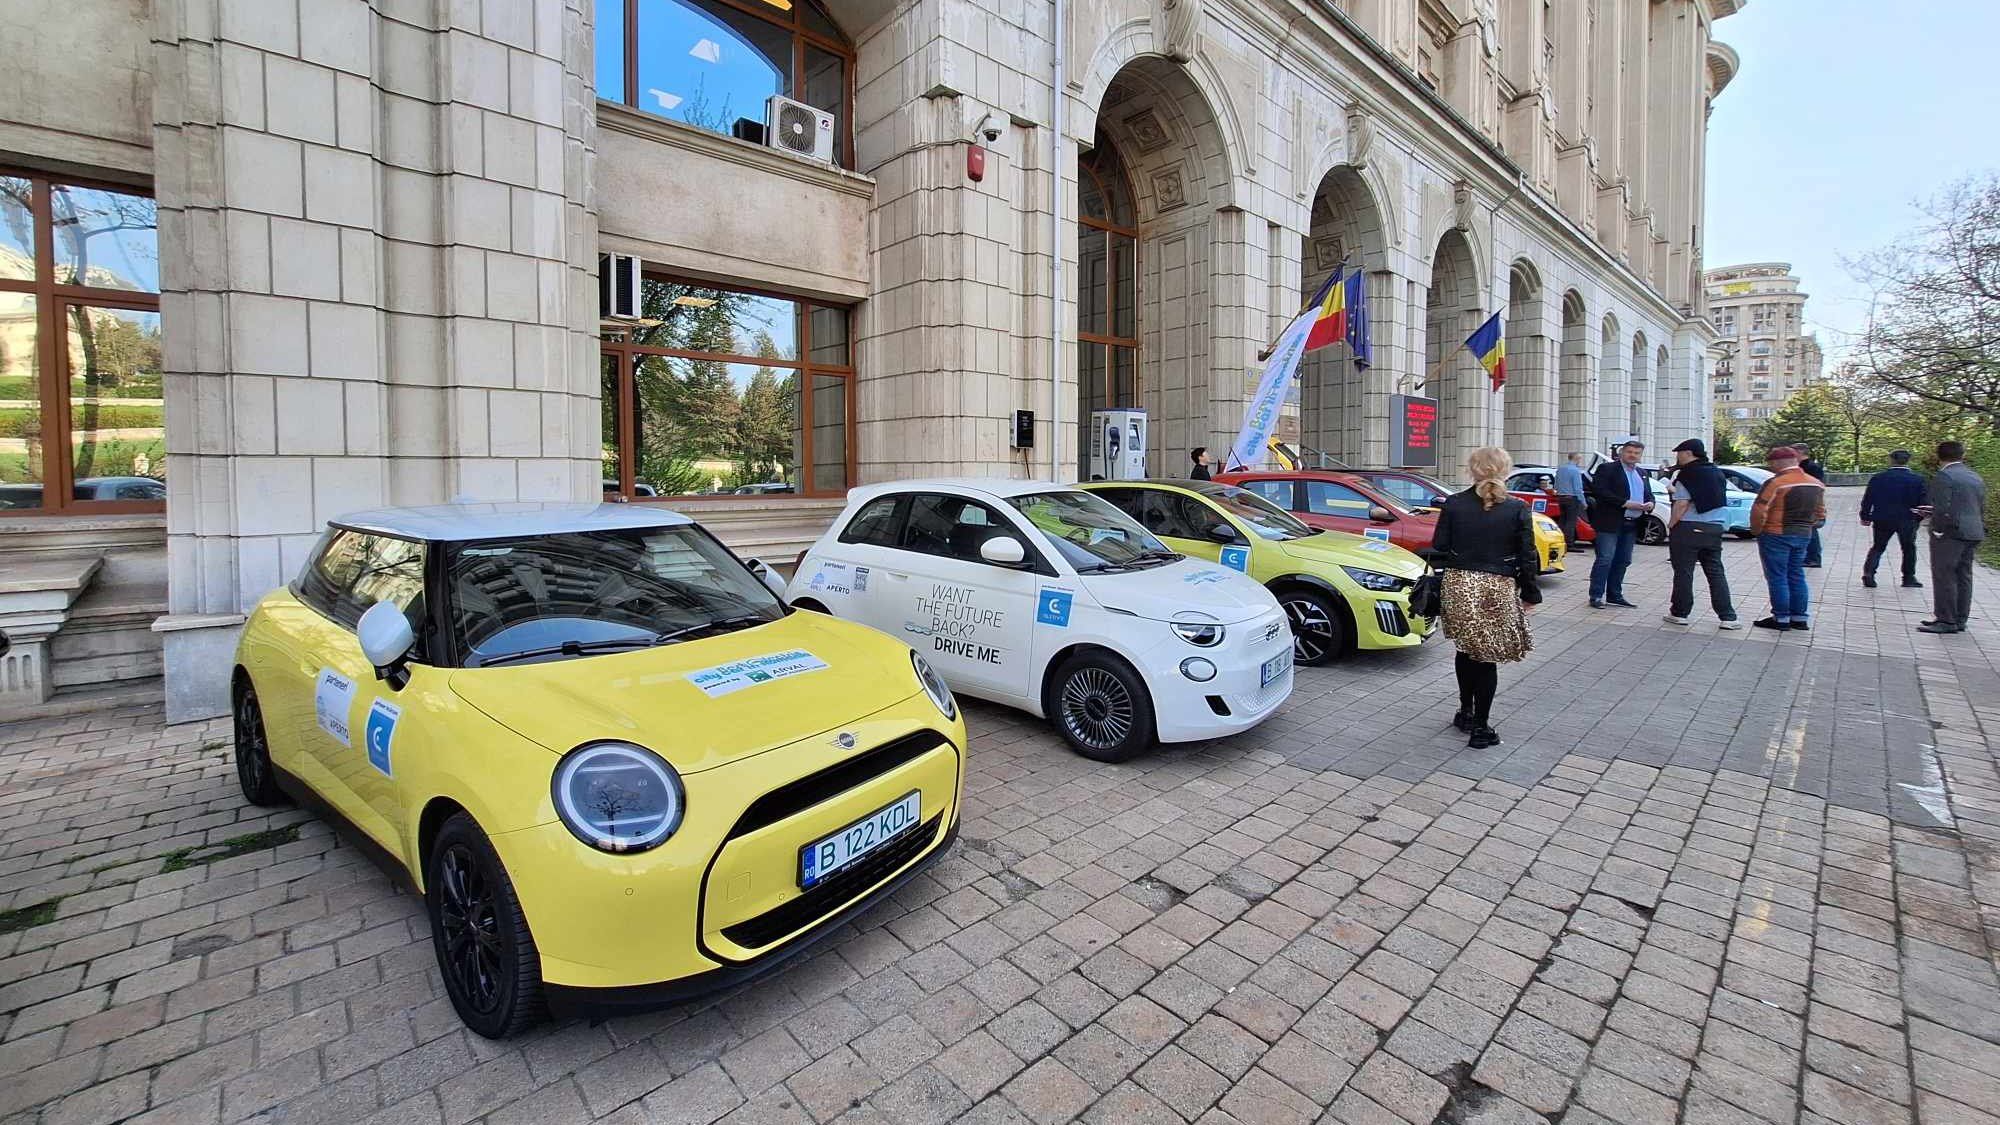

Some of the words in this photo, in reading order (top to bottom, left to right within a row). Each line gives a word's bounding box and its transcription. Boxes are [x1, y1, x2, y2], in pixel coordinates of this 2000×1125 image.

[827, 584, 850, 594] APERTO
[932, 583, 975, 604] WANT
[916, 597, 942, 616] THE
[945, 603, 1005, 629] FUTURE
[931, 617, 976, 640] BACK?
[934, 636, 974, 658] DRIVE
[977, 645, 1002, 665] ME.
[772, 663, 807, 675] ARVAL
[329, 719, 349, 740] APERTO
[804, 866, 815, 881] RO
[820, 841, 836, 871] B
[844, 822, 875, 857] 122
[880, 800, 915, 839] KDL
